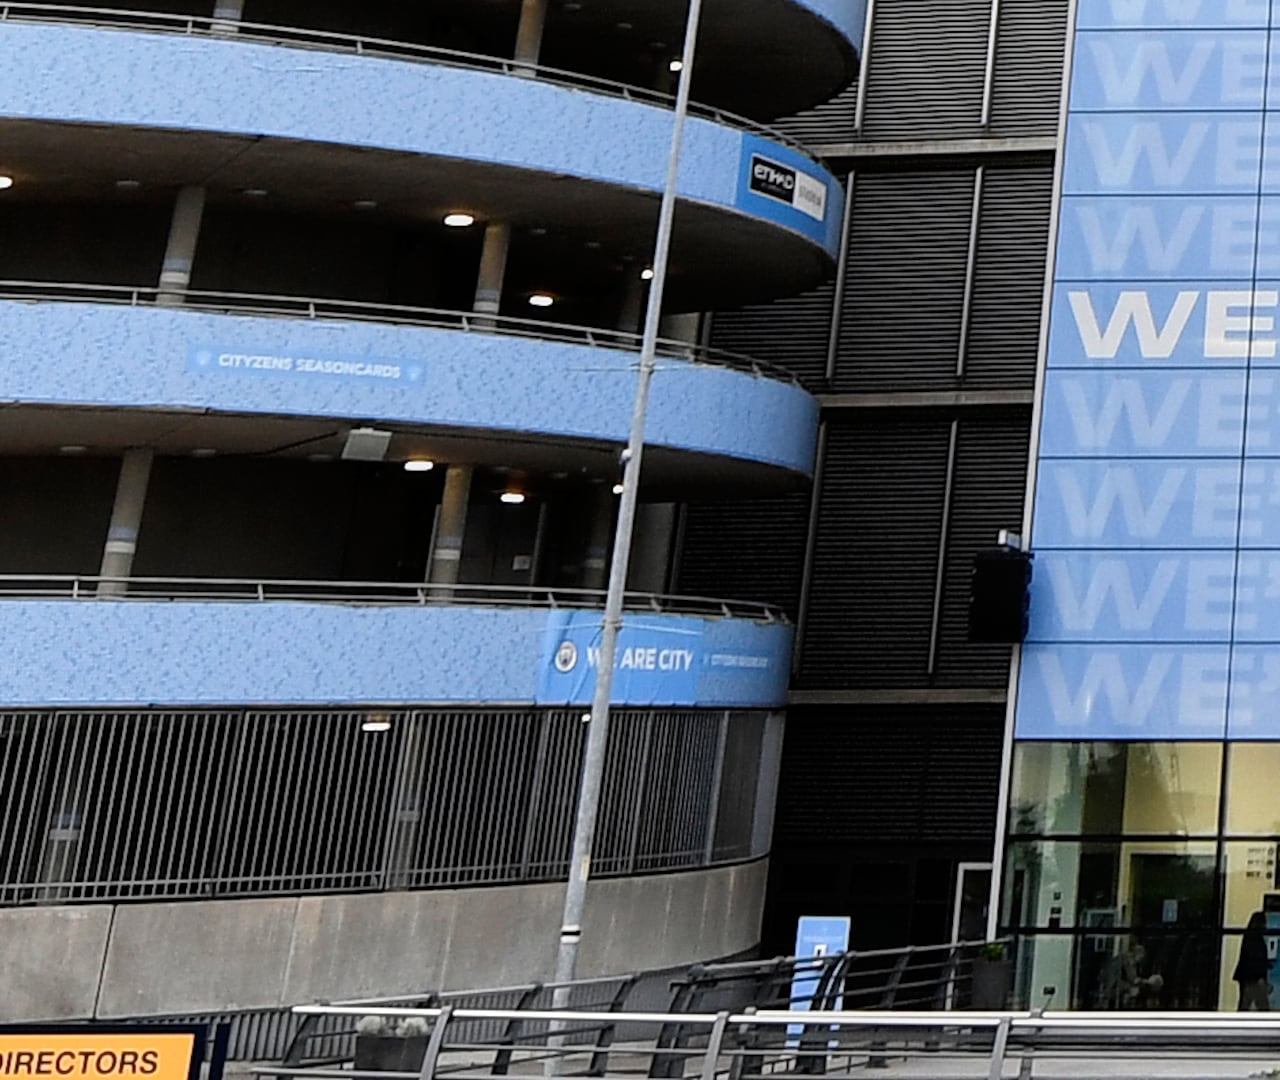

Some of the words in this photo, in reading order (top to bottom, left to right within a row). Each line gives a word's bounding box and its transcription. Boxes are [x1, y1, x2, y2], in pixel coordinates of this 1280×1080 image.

[218, 353, 293, 371] CITYZENS
[295, 358, 401, 379] SEASONCARDS
[620, 647, 657, 670] ARE
[658, 648, 694, 671] CITY
[0, 1050, 159, 1075] IRECTORS
